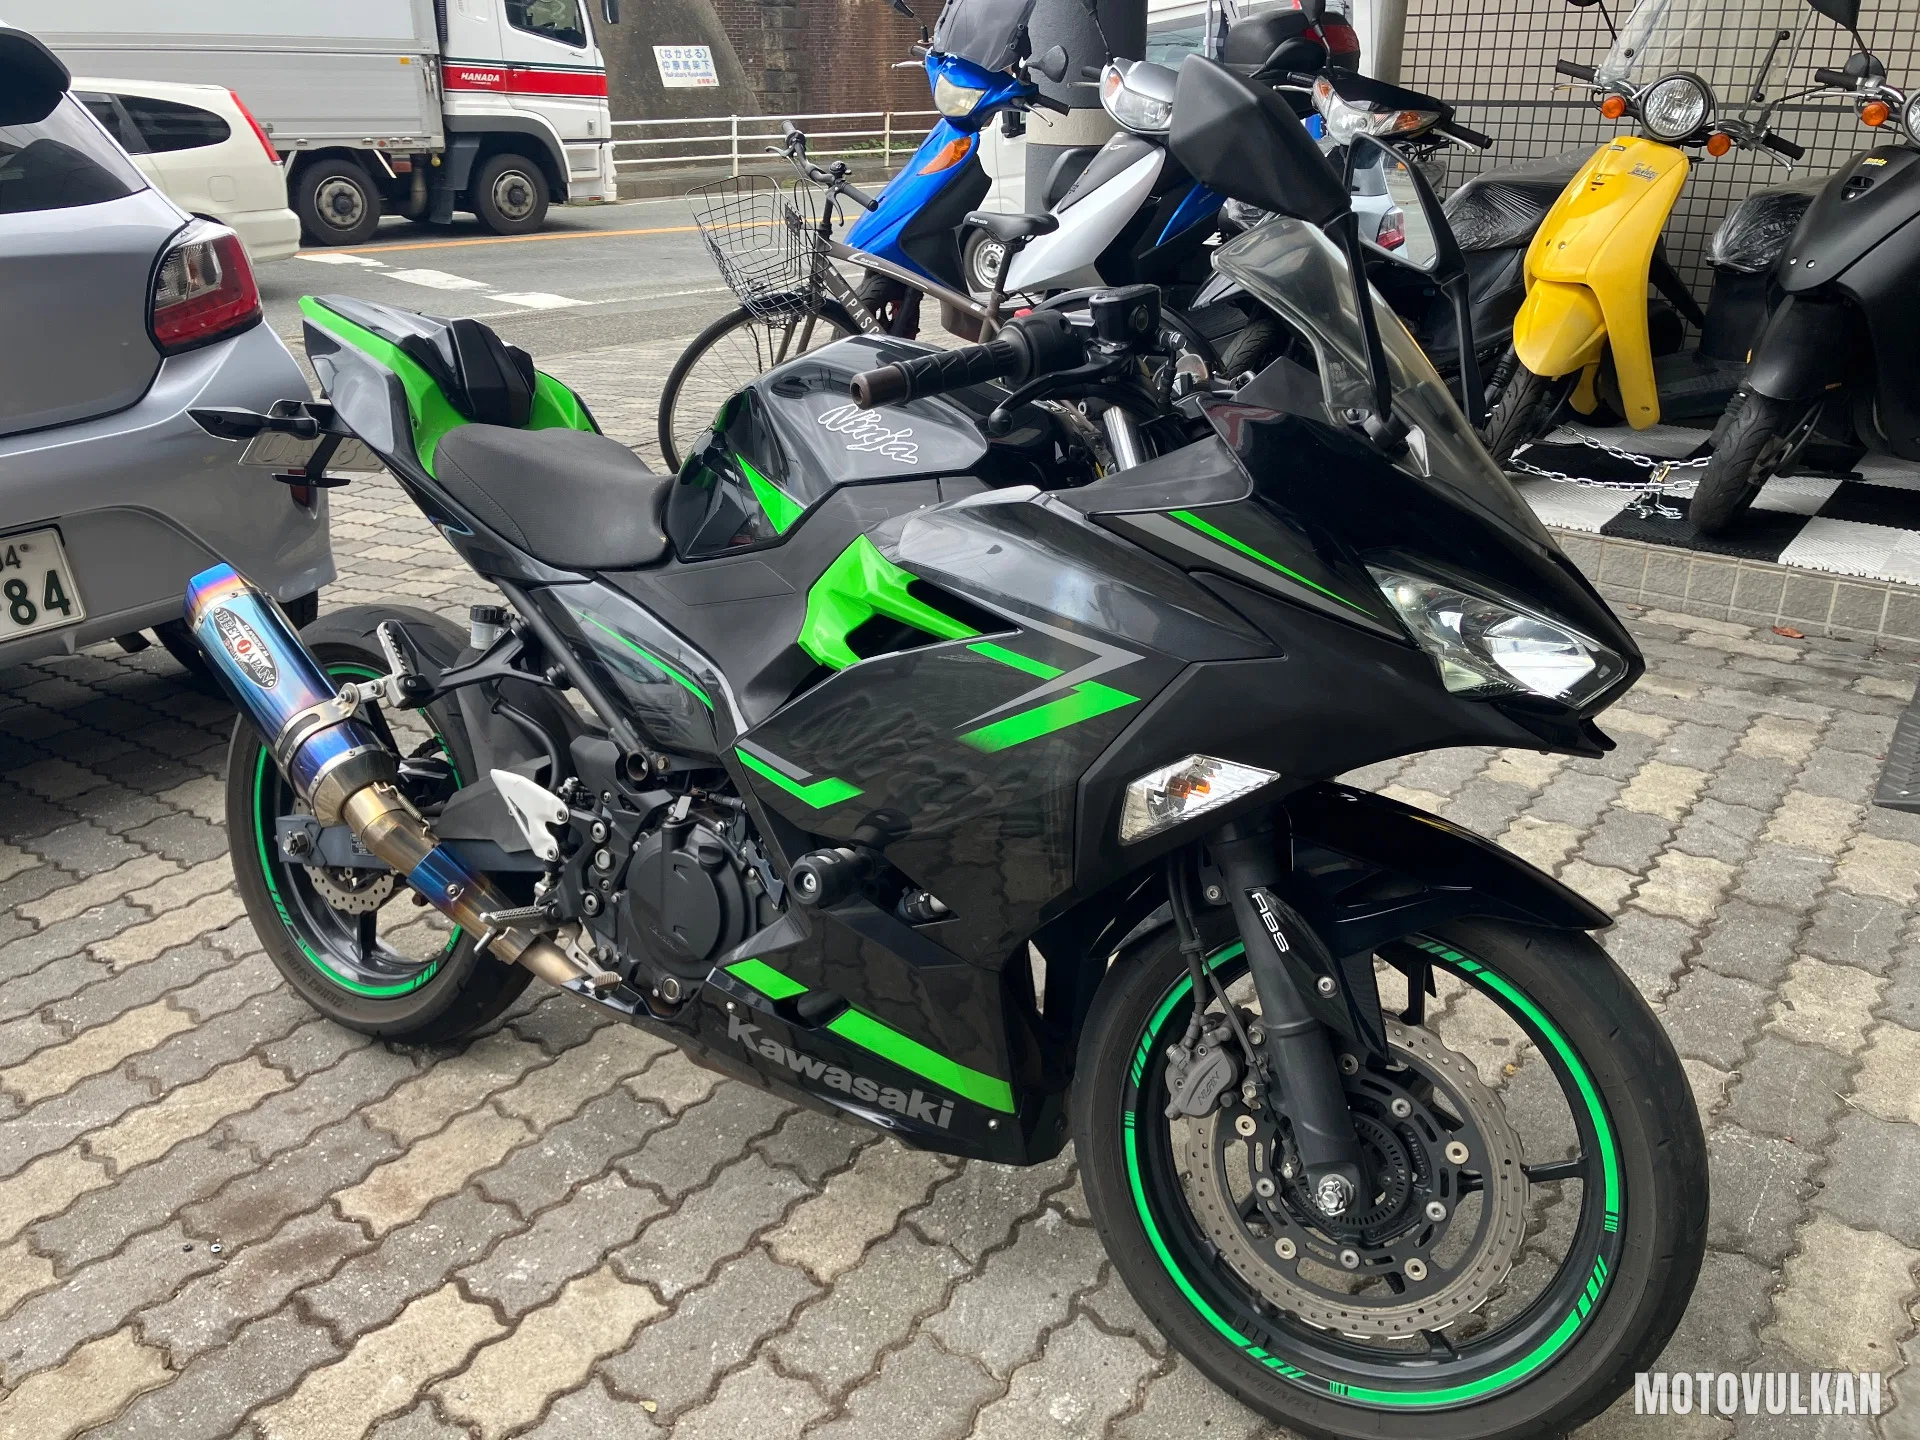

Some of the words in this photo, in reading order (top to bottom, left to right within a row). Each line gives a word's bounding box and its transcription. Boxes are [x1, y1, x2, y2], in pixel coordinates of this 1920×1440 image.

[461, 72, 500, 82] HANADA
[818, 403, 919, 465] Ninja
[0, 545, 21, 573] 4
[214, 610, 245, 642] BEET
[237, 640, 276, 683] JAPAN
[1251, 892, 1290, 953] ABS
[727, 1013, 955, 1130] Kawasaki
